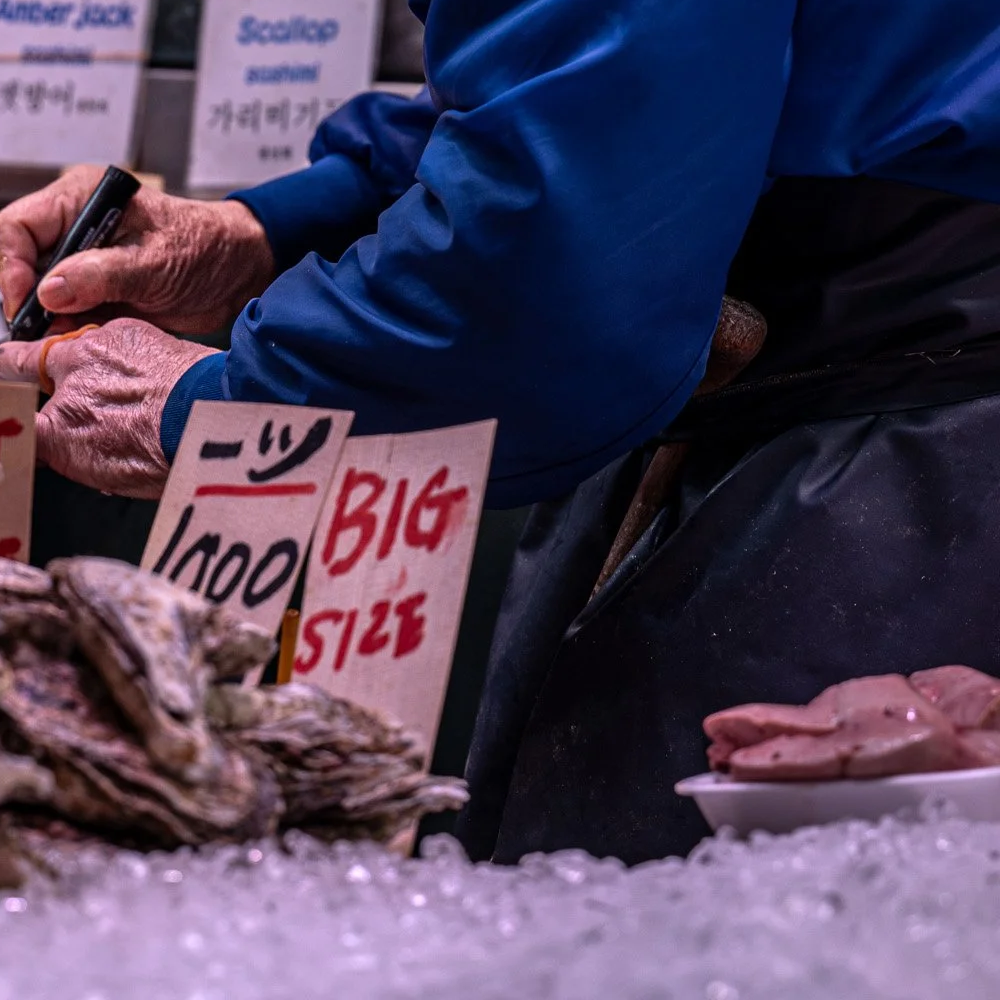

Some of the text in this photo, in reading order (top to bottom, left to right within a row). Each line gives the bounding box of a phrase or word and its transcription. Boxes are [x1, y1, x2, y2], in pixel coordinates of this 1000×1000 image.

[236, 16, 340, 47] Scallop
[152, 503, 299, 609] 1000
[321, 465, 469, 578] BIG
[292, 592, 427, 676] SIZE
